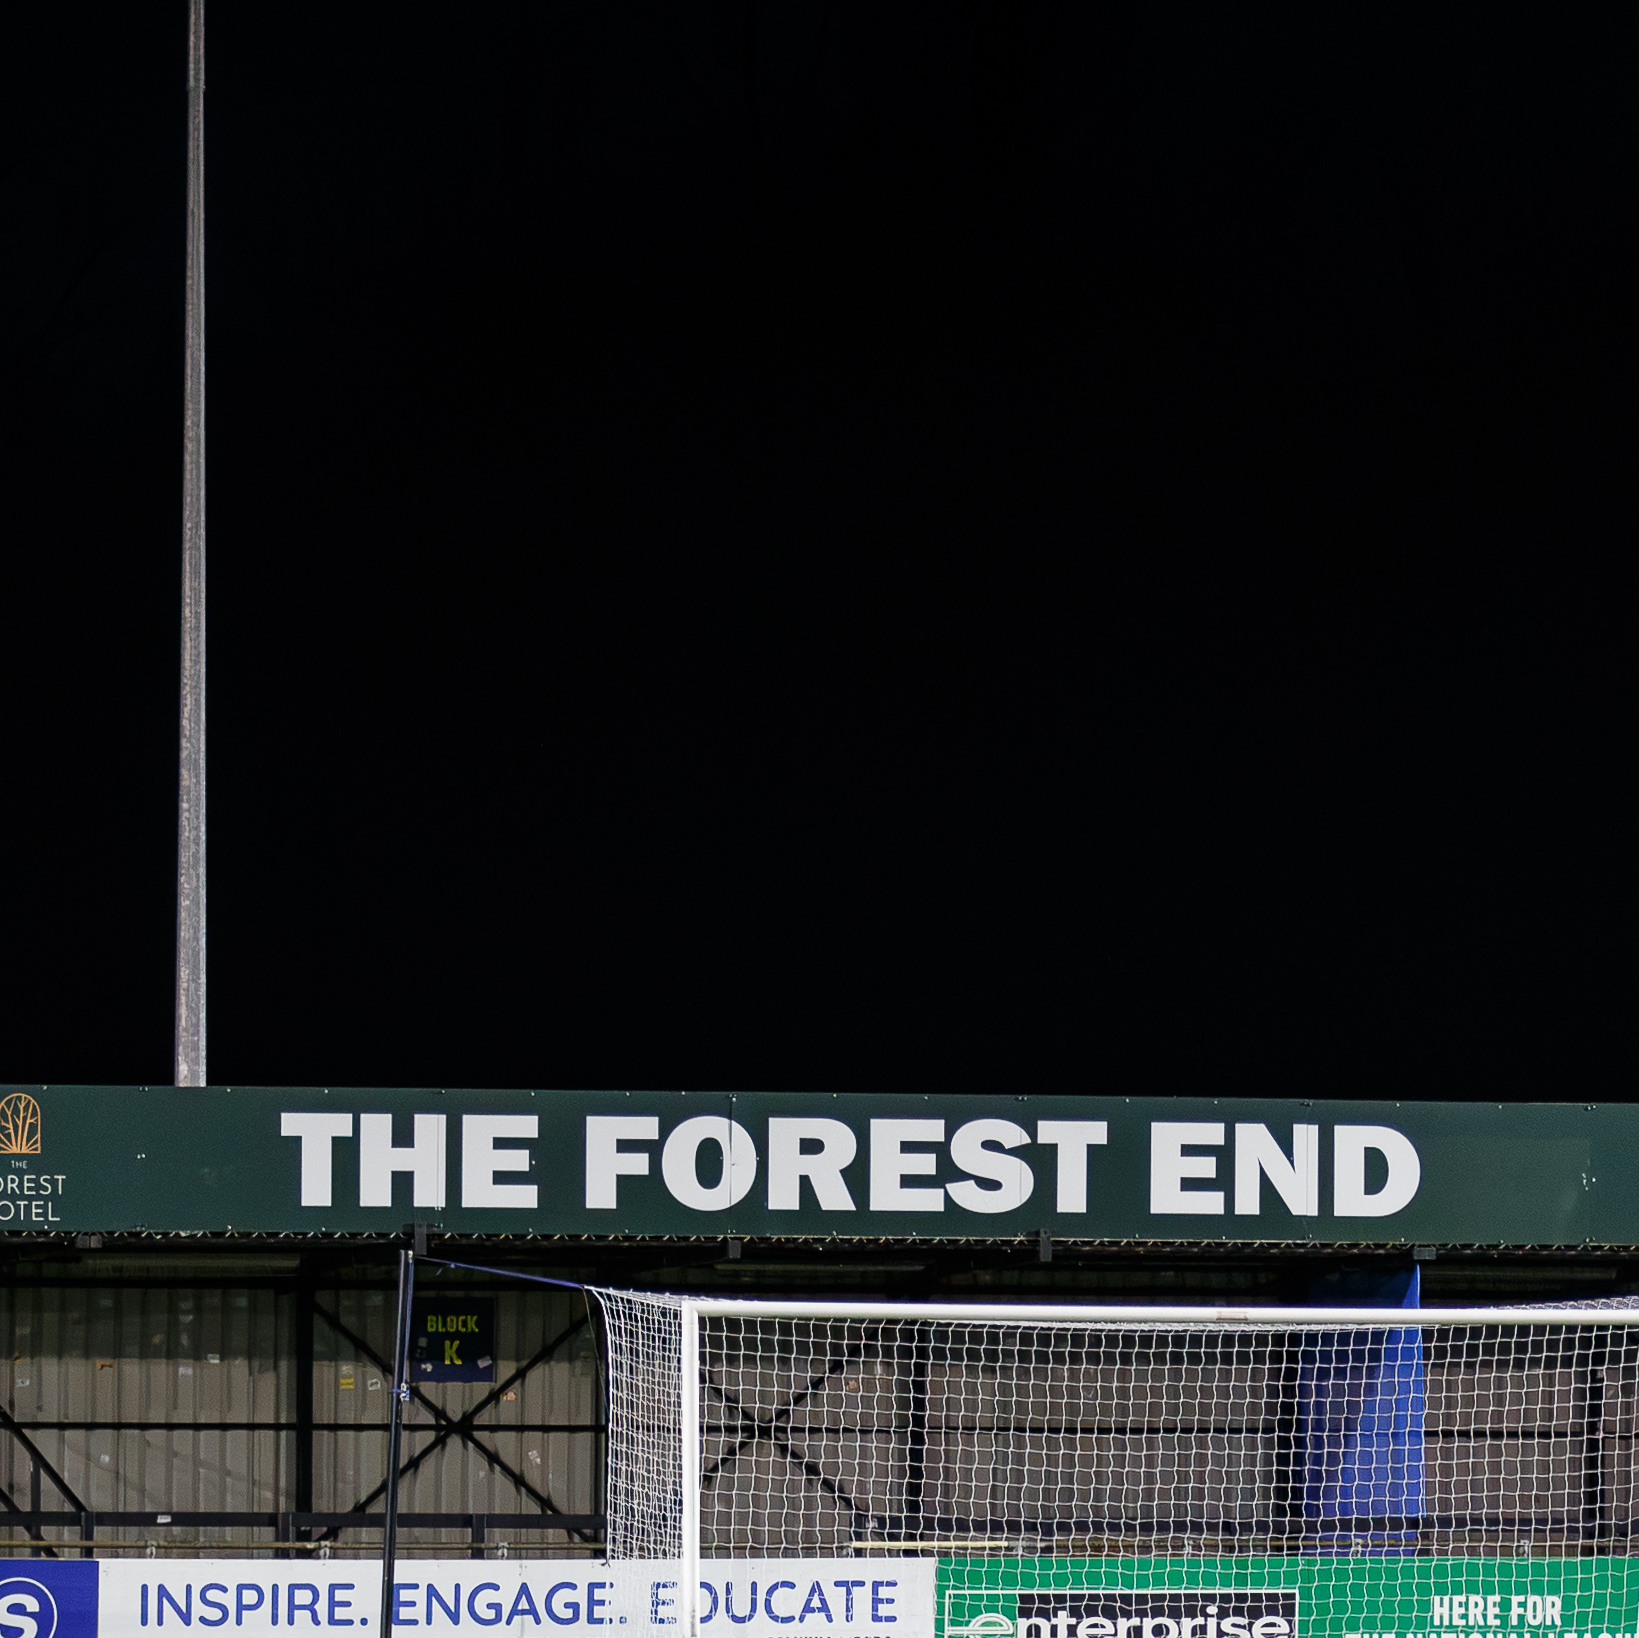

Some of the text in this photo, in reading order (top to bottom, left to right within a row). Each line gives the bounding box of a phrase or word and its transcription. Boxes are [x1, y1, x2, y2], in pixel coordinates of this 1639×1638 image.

[11, 1160, 29, 1169] THE
[280, 1112, 1422, 1218] THE FOREST END
[427, 1314, 479, 1333] BLOCK
[444, 1340, 463, 1365] K
[140, 1582, 369, 1627] INSPIRE.
[391, 1581, 628, 1627] ENGAGE.
[1432, 1595, 1563, 1627] HERE FOR
